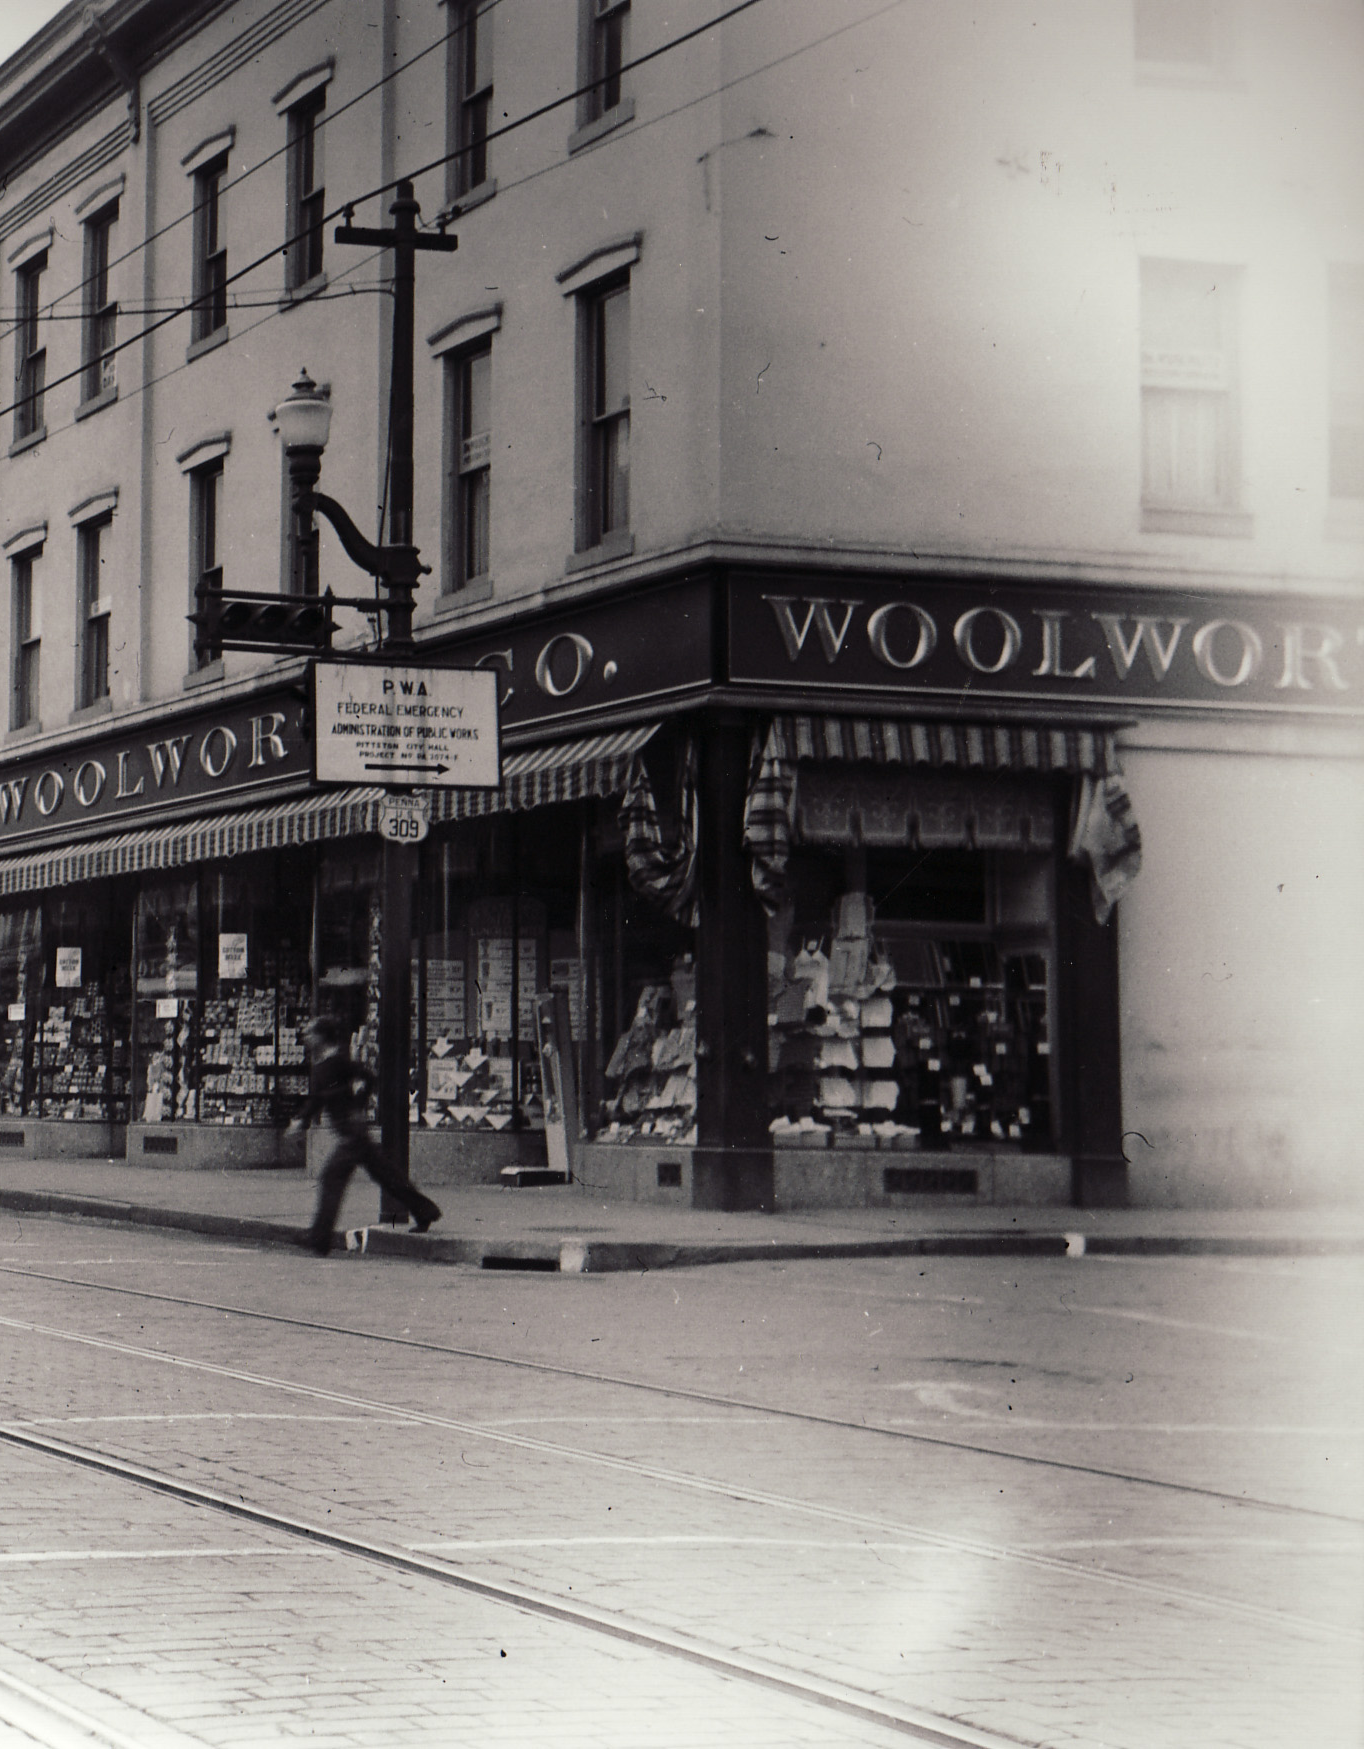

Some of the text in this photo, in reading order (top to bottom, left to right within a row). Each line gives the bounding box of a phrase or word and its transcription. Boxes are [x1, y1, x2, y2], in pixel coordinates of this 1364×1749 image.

[760, 594, 1364, 690] WOOLWOR
[337, 702, 464, 719] FEDERAL EMERGENCY
[331, 723, 479, 741] ADMINISTRATION OF PUBLIC WORKS
[356, 741, 399, 750] PITTSTON
[359, 750, 395, 759] PROJECT
[389, 797, 420, 807] PENNA
[389, 818, 419, 838] 309
